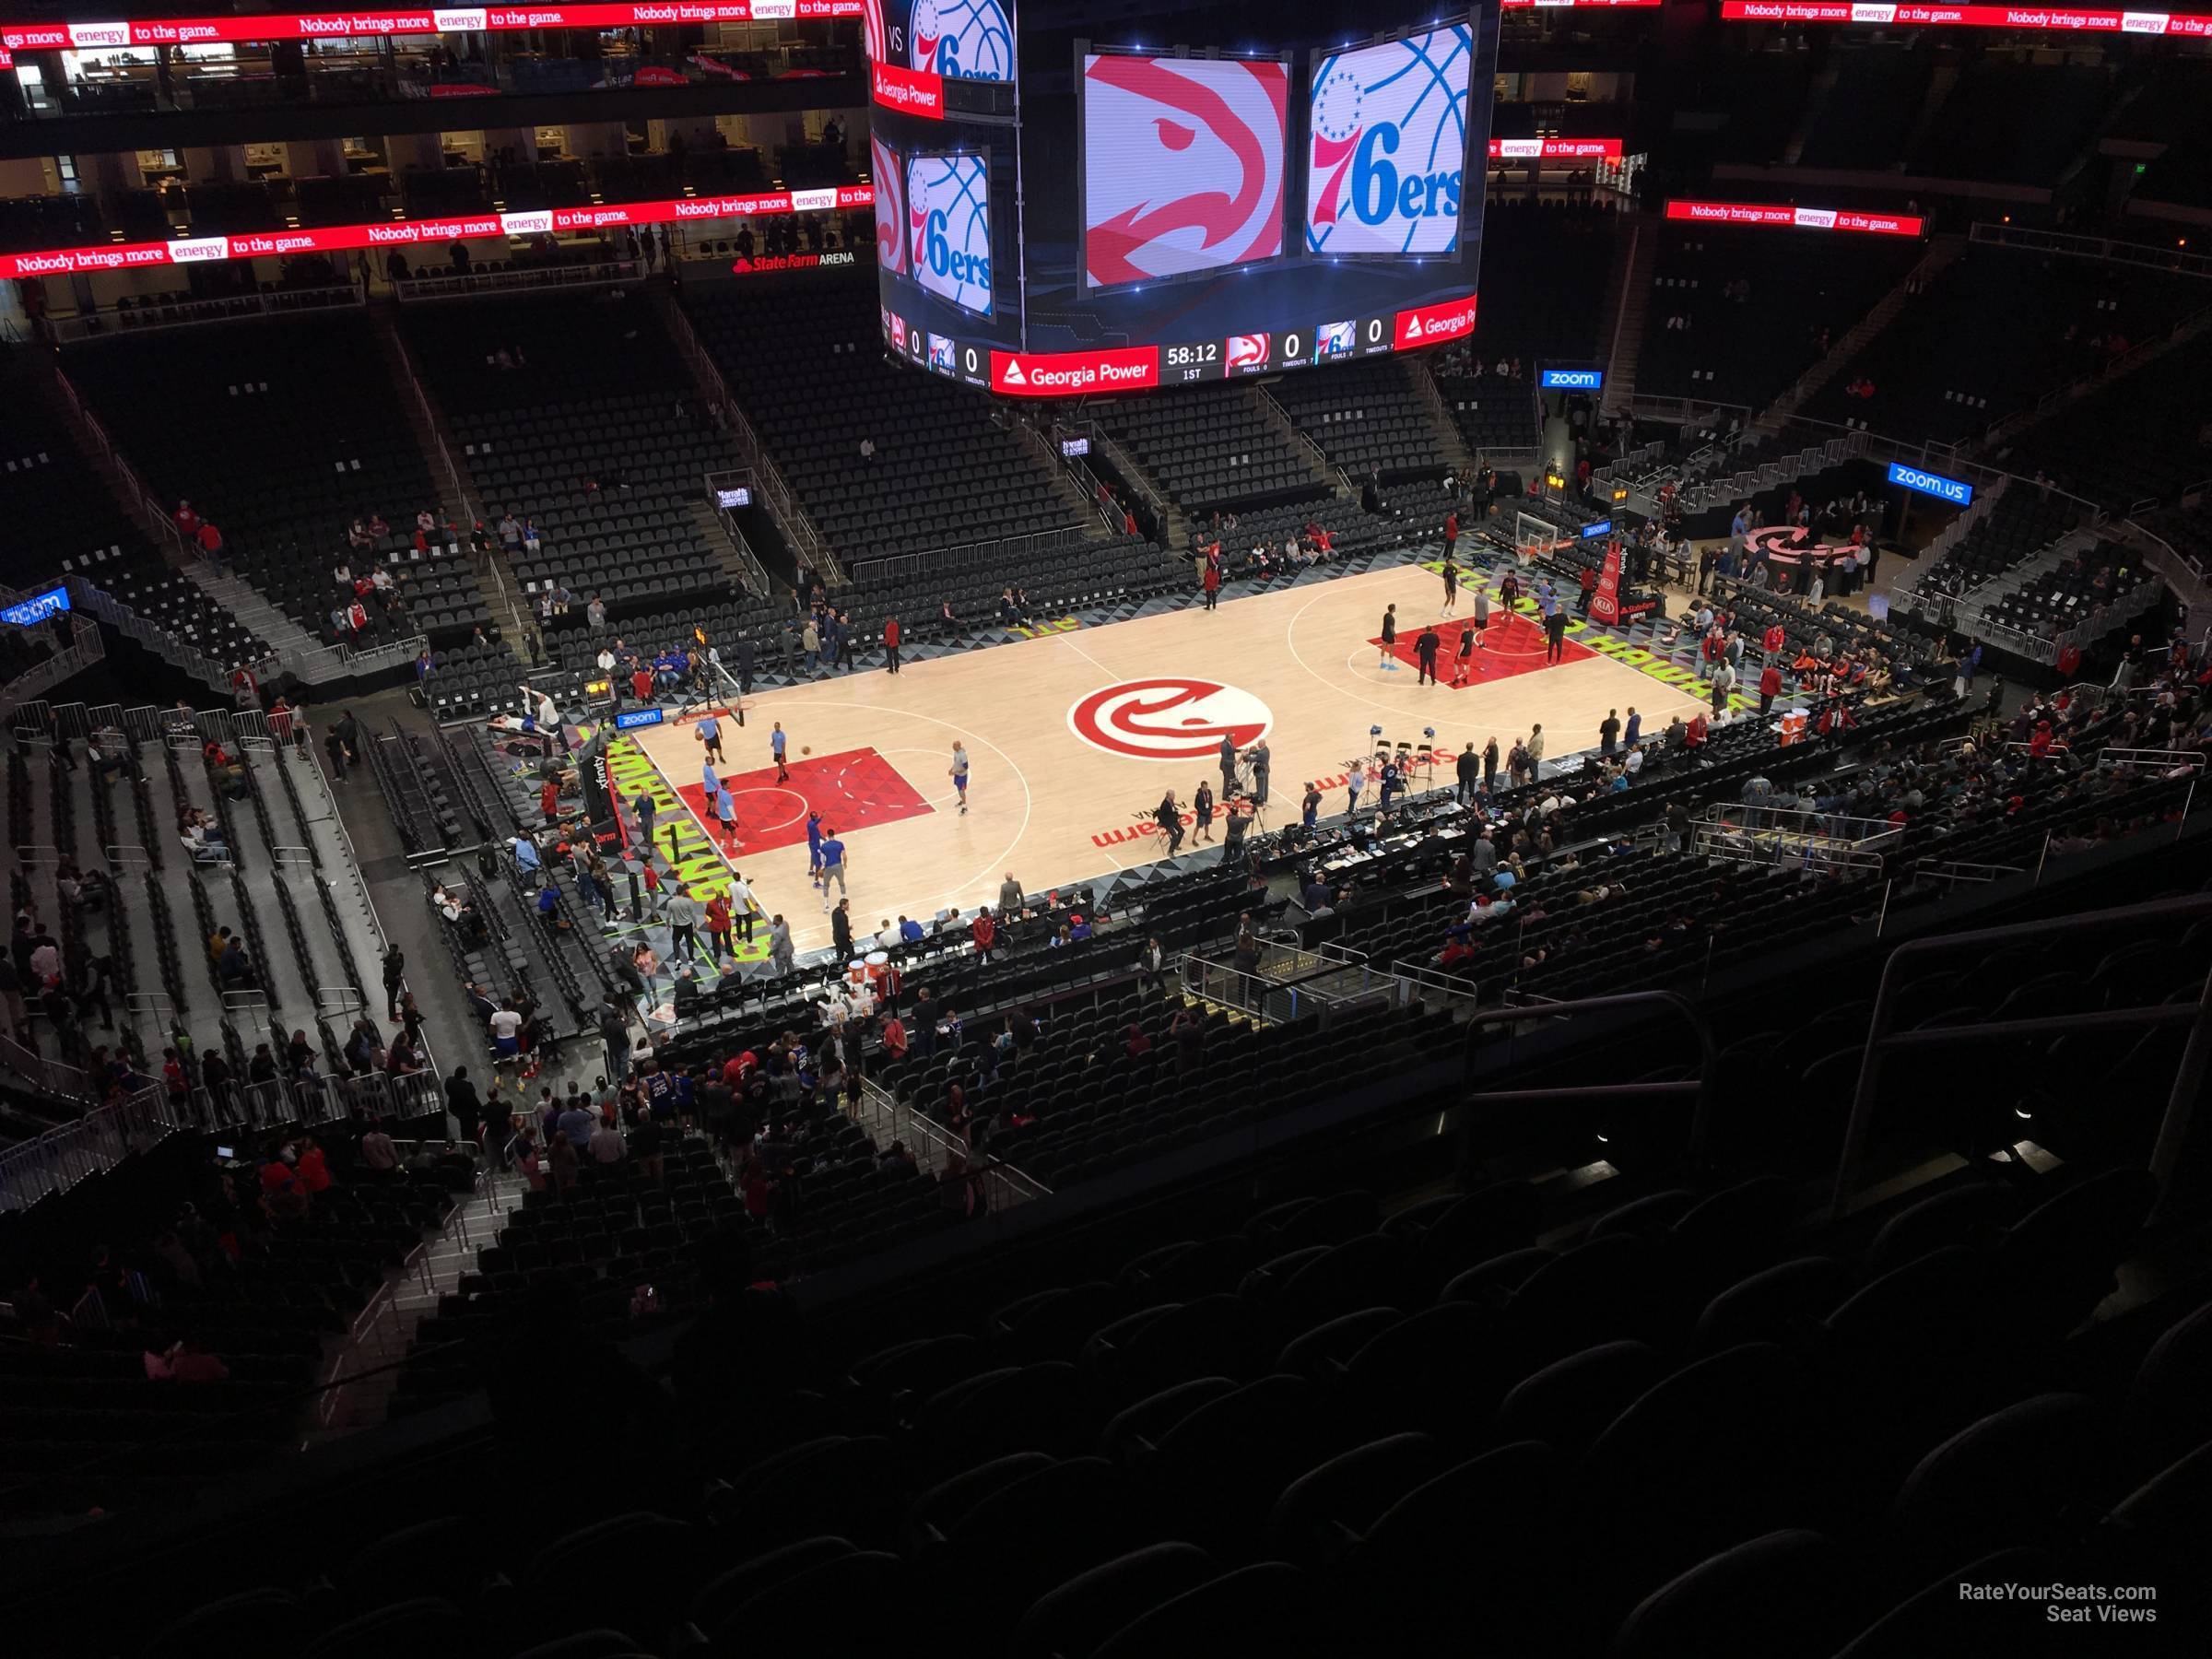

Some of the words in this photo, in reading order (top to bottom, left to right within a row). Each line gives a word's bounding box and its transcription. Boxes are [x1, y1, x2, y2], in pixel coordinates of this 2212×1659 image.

[633, 6, 677, 21] Nobody
[680, 5, 715, 19] brings
[718, 6, 746, 17] more
[755, 4, 792, 17] energy
[800, 2, 811, 13] to
[813, 1, 830, 13] the
[832, 3, 864, 15] game.
[1745, 5, 1784, 18] Nobody
[1786, 5, 1818, 18] brings
[1820, 8, 1847, 17] more
[1855, 9, 1891, 20] energy
[1900, 10, 1910, 19] to
[1912, 9, 1929, 19] the
[1931, 12, 1961, 22] game.
[2007, 11, 2050, 26] Nobody
[2051, 13, 2086, 28] brings
[2088, 17, 2117, 26] more
[2126, 18, 2163, 30] energy
[2171, 20, 2183, 30] to
[2185, 19, 2203, 31] the
[300, 18, 350, 33] Nobody
[354, 16, 394, 32] brings
[397, 18, 429, 29] more
[440, 14, 482, 29] energy
[491, 13, 504, 25] to
[507, 12, 526, 24] the
[529, 12, 563, 26] game.
[27, 30, 64, 43] more
[76, 29, 124, 44] energy
[135, 27, 150, 40] to
[153, 26, 177, 39] the
[179, 26, 219, 41] game.
[883, 78, 908, 103] Georgia
[909, 85, 936, 107] Power
[1504, 144, 1539, 155] energy
[1546, 144, 1557, 153] to
[1559, 143, 1575, 153] the
[1576, 144, 1606, 155] game.
[676, 201, 719, 216] Nobody
[722, 199, 758, 214] brings
[759, 197, 788, 209] more
[796, 194, 833, 206] energy
[841, 191, 853, 203] to
[854, 190, 872, 201] the
[369, 224, 419, 241] Nobody
[421, 221, 462, 237] brings
[465, 220, 496, 232] more
[507, 216, 548, 230] energy
[558, 213, 570, 225] to
[572, 211, 592, 224] the
[594, 210, 629, 225] game.
[1691, 206, 1730, 219] Nobody
[1732, 206, 1762, 221] brings
[1764, 210, 1790, 220] more
[1798, 213, 1833, 226] energy
[1839, 216, 1850, 226] to
[1851, 216, 1868, 228] the
[1870, 219, 1899, 230] game.
[16, 251, 75, 272] Nobody
[77, 248, 124, 267] brings
[125, 246, 163, 262] more
[175, 242, 223, 258] energy
[233, 239, 249, 253] to
[252, 237, 274, 251] the
[276, 235, 315, 253] game.
[818, 252, 855, 266] ARENA
[1369, 319, 1382, 343] 0
[1425, 312, 1465, 335] Georgia
[912, 330, 920, 354] 0
[1285, 334, 1300, 358] 0
[965, 348, 978, 372] 0
[1168, 344, 1217, 365] 58:12
[1282, 359, 1307, 368] TIMEOUTS
[1030, 367, 1089, 387] Georgia
[1100, 363, 1149, 381] Power
[1183, 369, 1201, 381] 1ST
[1550, 372, 1594, 385] zoom
[1896, 467, 1964, 500] zoom.us
[1618, 547, 1629, 575] xfinity
[1596, 598, 1611, 613] KIA
[622, 712, 656, 725] zoom
[593, 755, 609, 790] xfinity
[653, 1085, 668, 1098] 25
